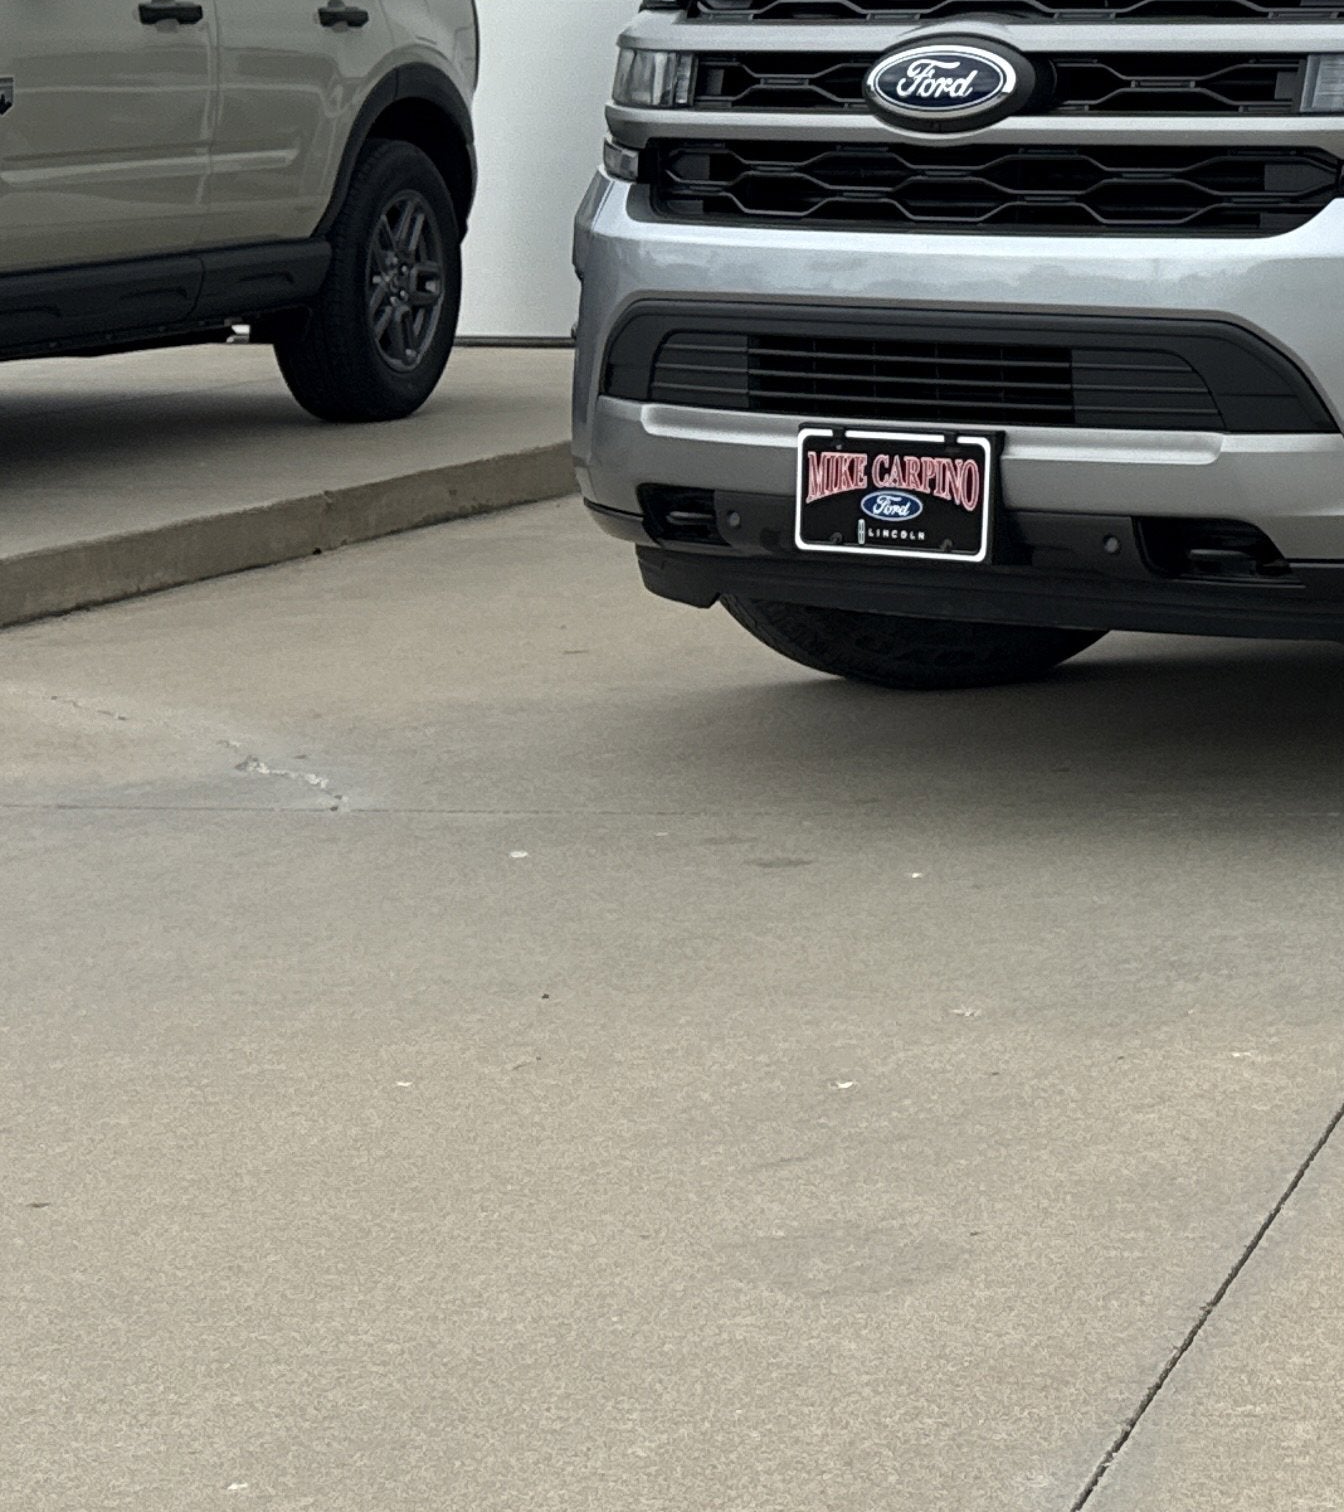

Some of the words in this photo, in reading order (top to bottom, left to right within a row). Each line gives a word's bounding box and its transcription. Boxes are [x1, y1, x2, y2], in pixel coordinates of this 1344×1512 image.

[896, 59, 978, 97] Ford
[807, 451, 867, 503] MIKE
[872, 454, 979, 510] CARPINO
[872, 494, 911, 517] Ford
[868, 528, 925, 539] LINCOLN
